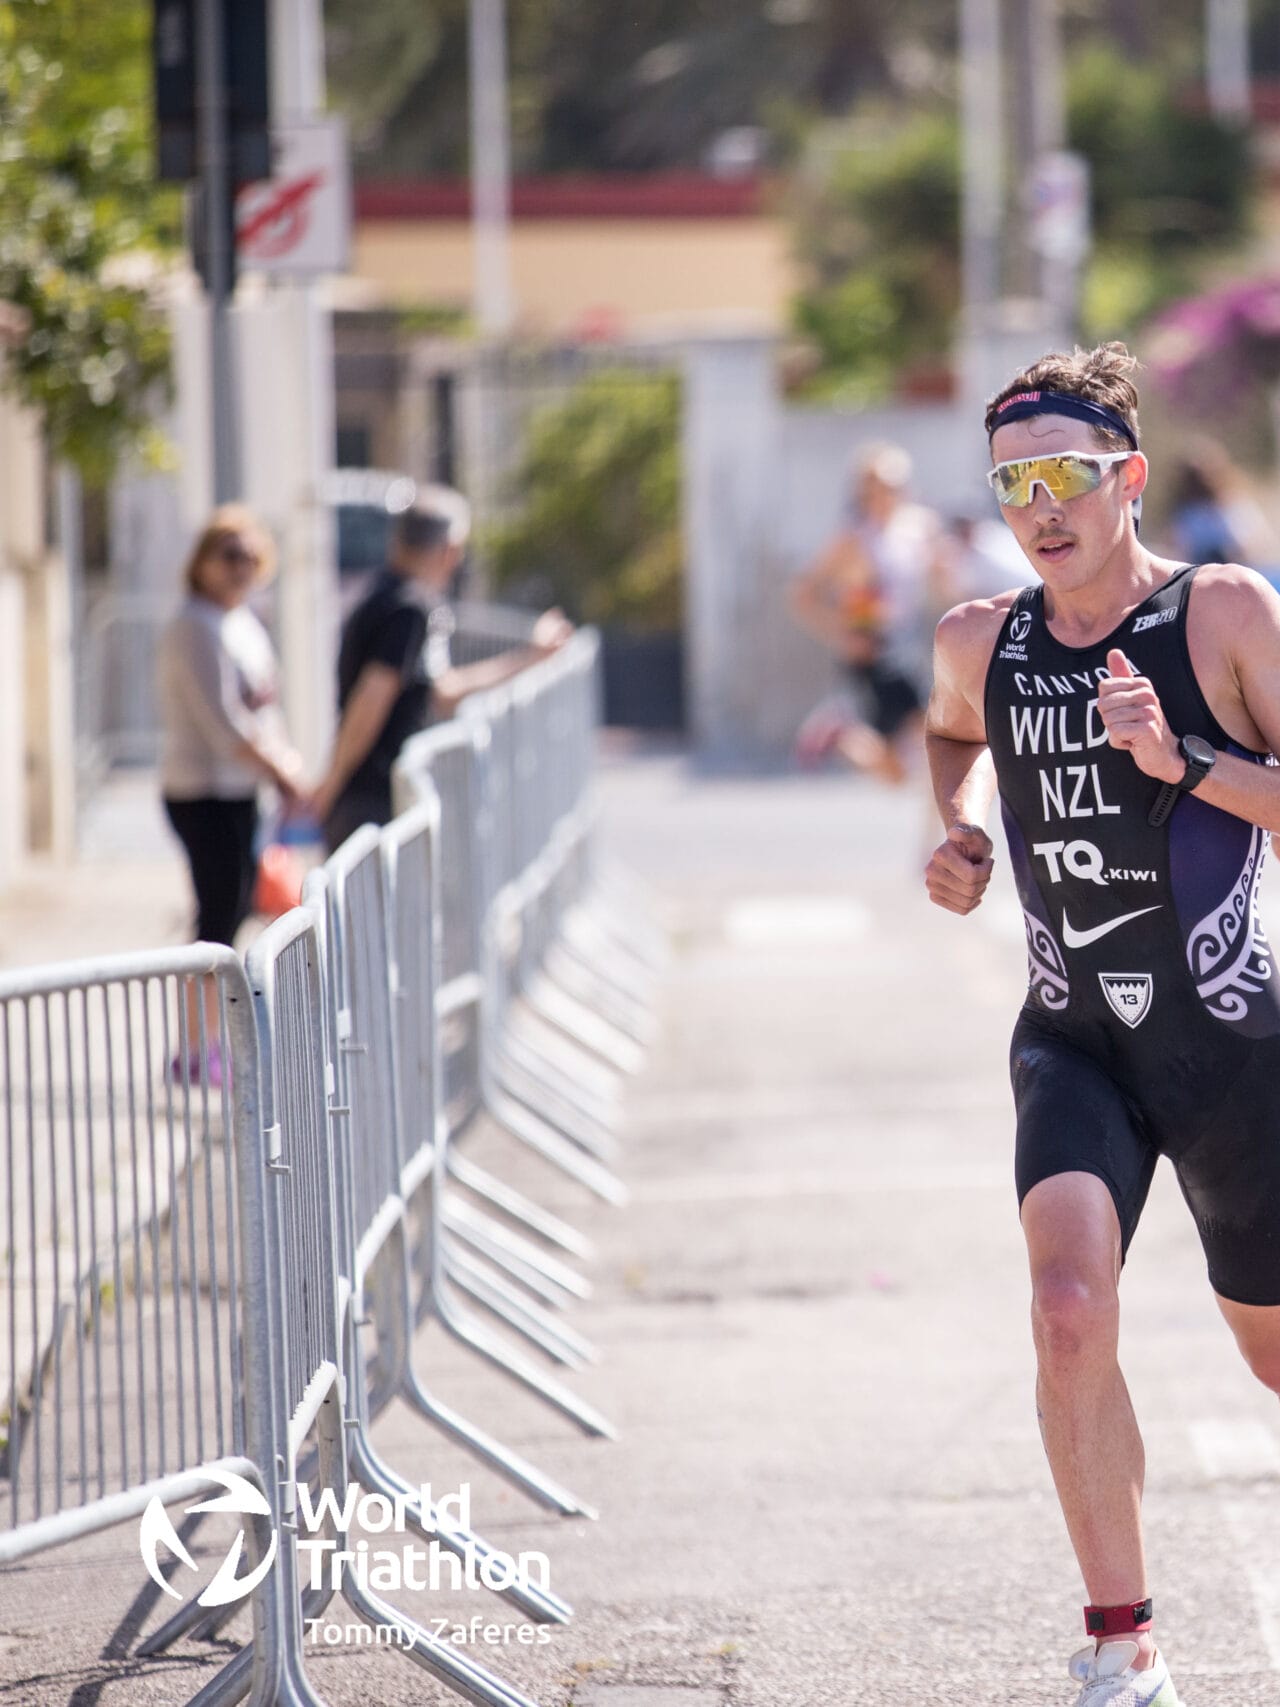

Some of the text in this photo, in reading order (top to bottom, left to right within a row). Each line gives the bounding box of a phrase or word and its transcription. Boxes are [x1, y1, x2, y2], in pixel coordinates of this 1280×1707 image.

[1006, 643, 1026, 652] World
[999, 650, 1028, 661] Triathlon
[1039, 763, 1121, 822] NZL
[1119, 994, 1138, 1005] 13
